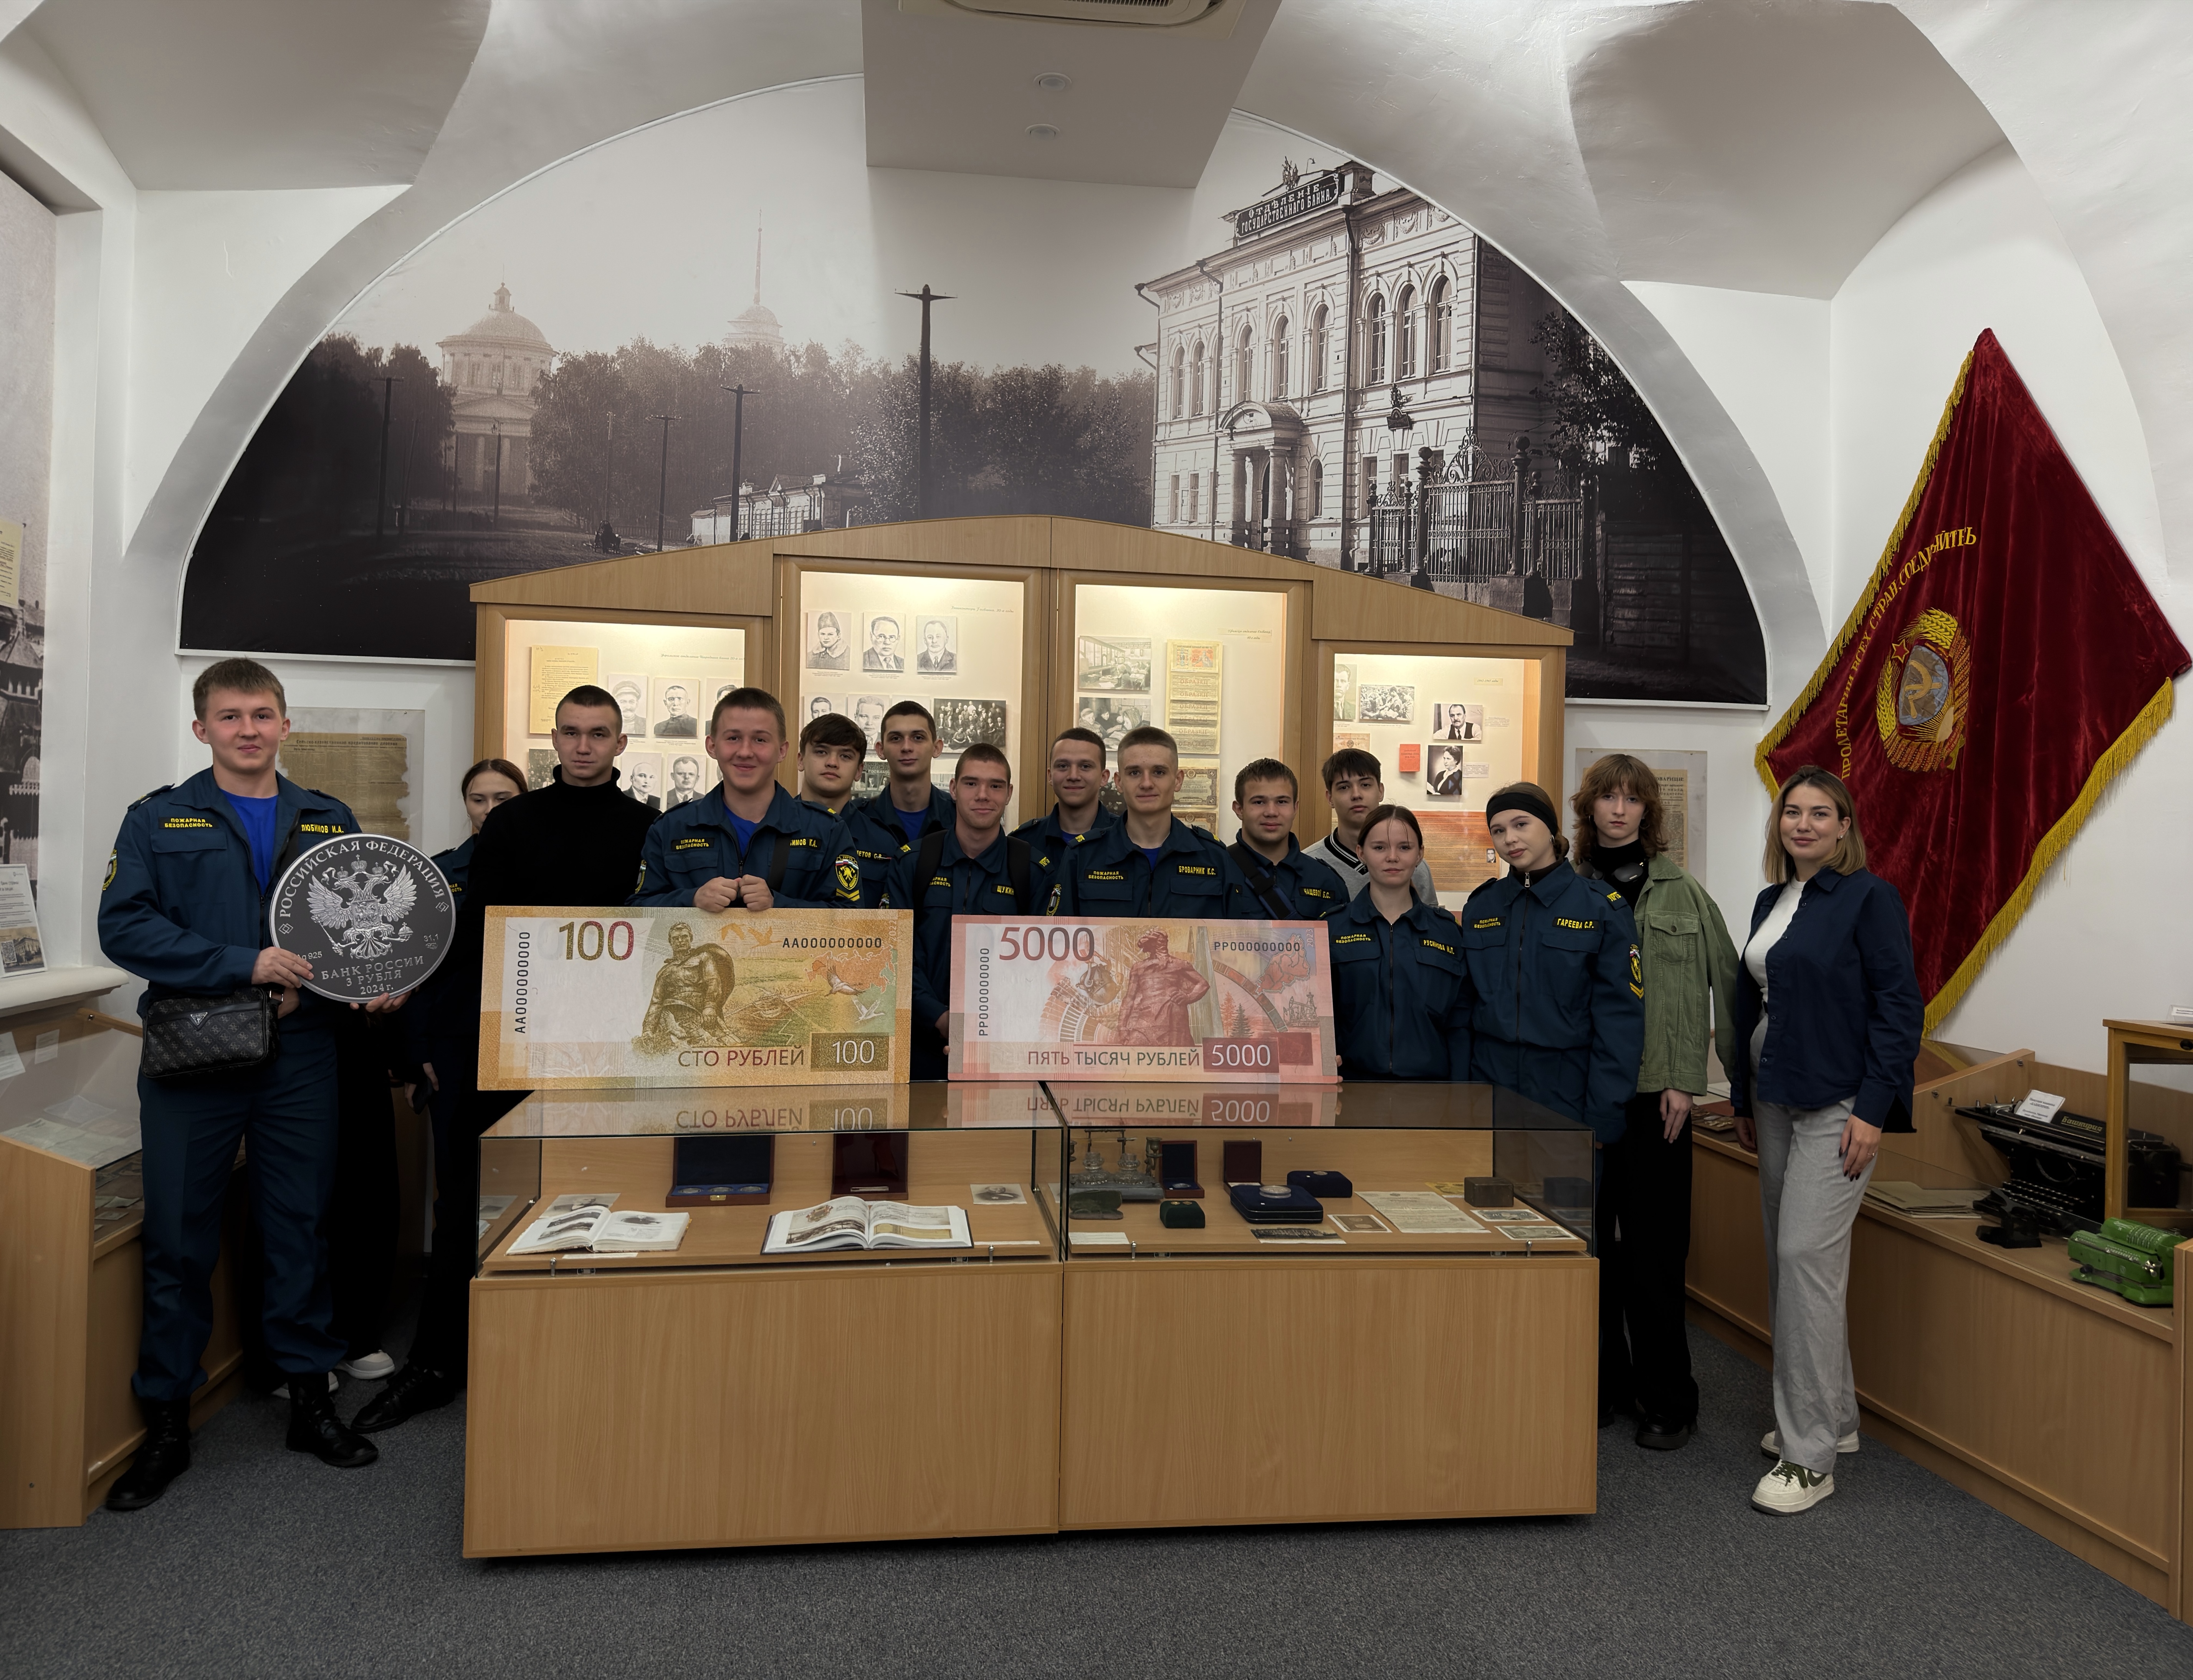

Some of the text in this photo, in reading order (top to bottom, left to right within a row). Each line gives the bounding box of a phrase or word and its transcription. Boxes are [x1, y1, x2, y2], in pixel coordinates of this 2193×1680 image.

[1242, 189, 1332, 233] ГОСУДАРСТВЕННАГО БАНКА.
[1851, 630, 1871, 671] ВСЕХ
[301, 824, 328, 833] ЛЮБИМОВ
[280, 840, 445, 918] РОССИЙСКАЯ ФЕДЕРАЦИЯ
[1179, 866, 1205, 875] БРОВАРНИК
[1304, 888, 1322, 897] ЧАЩЕВОЙ
[1557, 918, 1594, 929] ГАРЕЕВА С.Р.
[559, 921, 634, 961] 100
[999, 926, 1095, 961] 5000
[1424, 939, 1445, 951] РУСИНОВА
[308, 951, 322, 959] 925
[321, 956, 424, 980] БАНК РОССИИ
[346, 969, 402, 986] 3 РУБЛЯ
[360, 985, 384, 995] 2024
[678, 1045, 804, 1067] СТО РУБЛЕЙ
[832, 1040, 875, 1064] 100
[1028, 1049, 1200, 1066] ПЯТЬ ТЫСЯЧ РУБЛЕЙ
[1211, 1044, 1271, 1067] 5000
[2061, 1115, 2103, 1132] Башкирия
